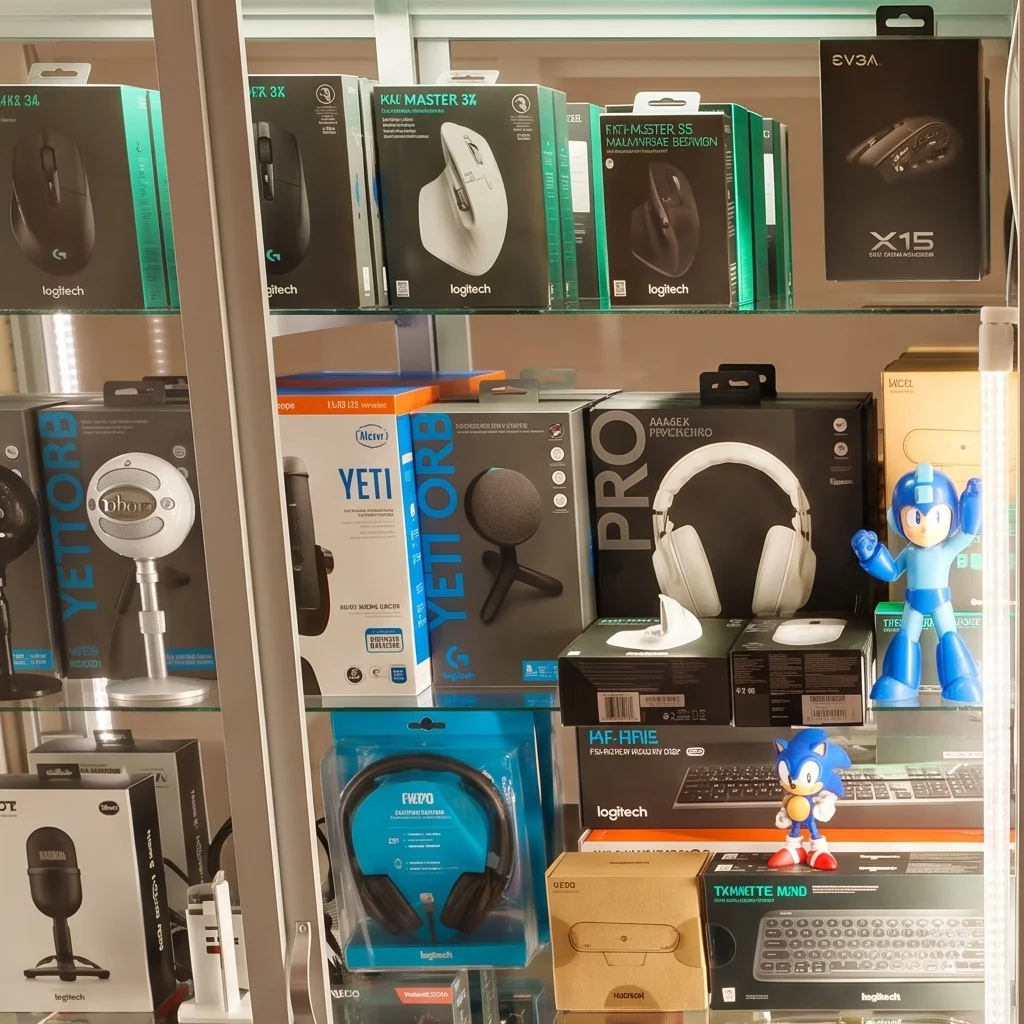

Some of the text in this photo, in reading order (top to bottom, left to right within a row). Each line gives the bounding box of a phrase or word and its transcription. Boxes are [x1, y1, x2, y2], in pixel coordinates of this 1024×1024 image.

[404, 93, 459, 107] MASTER
[869, 231, 934, 251] X15
[42, 284, 85, 299] logitech
[450, 283, 492, 299] logitech
[648, 283, 689, 299] logitech
[338, 468, 393, 500] YETI
[590, 409, 652, 550] PRO
[597, 805, 648, 821] logitech
